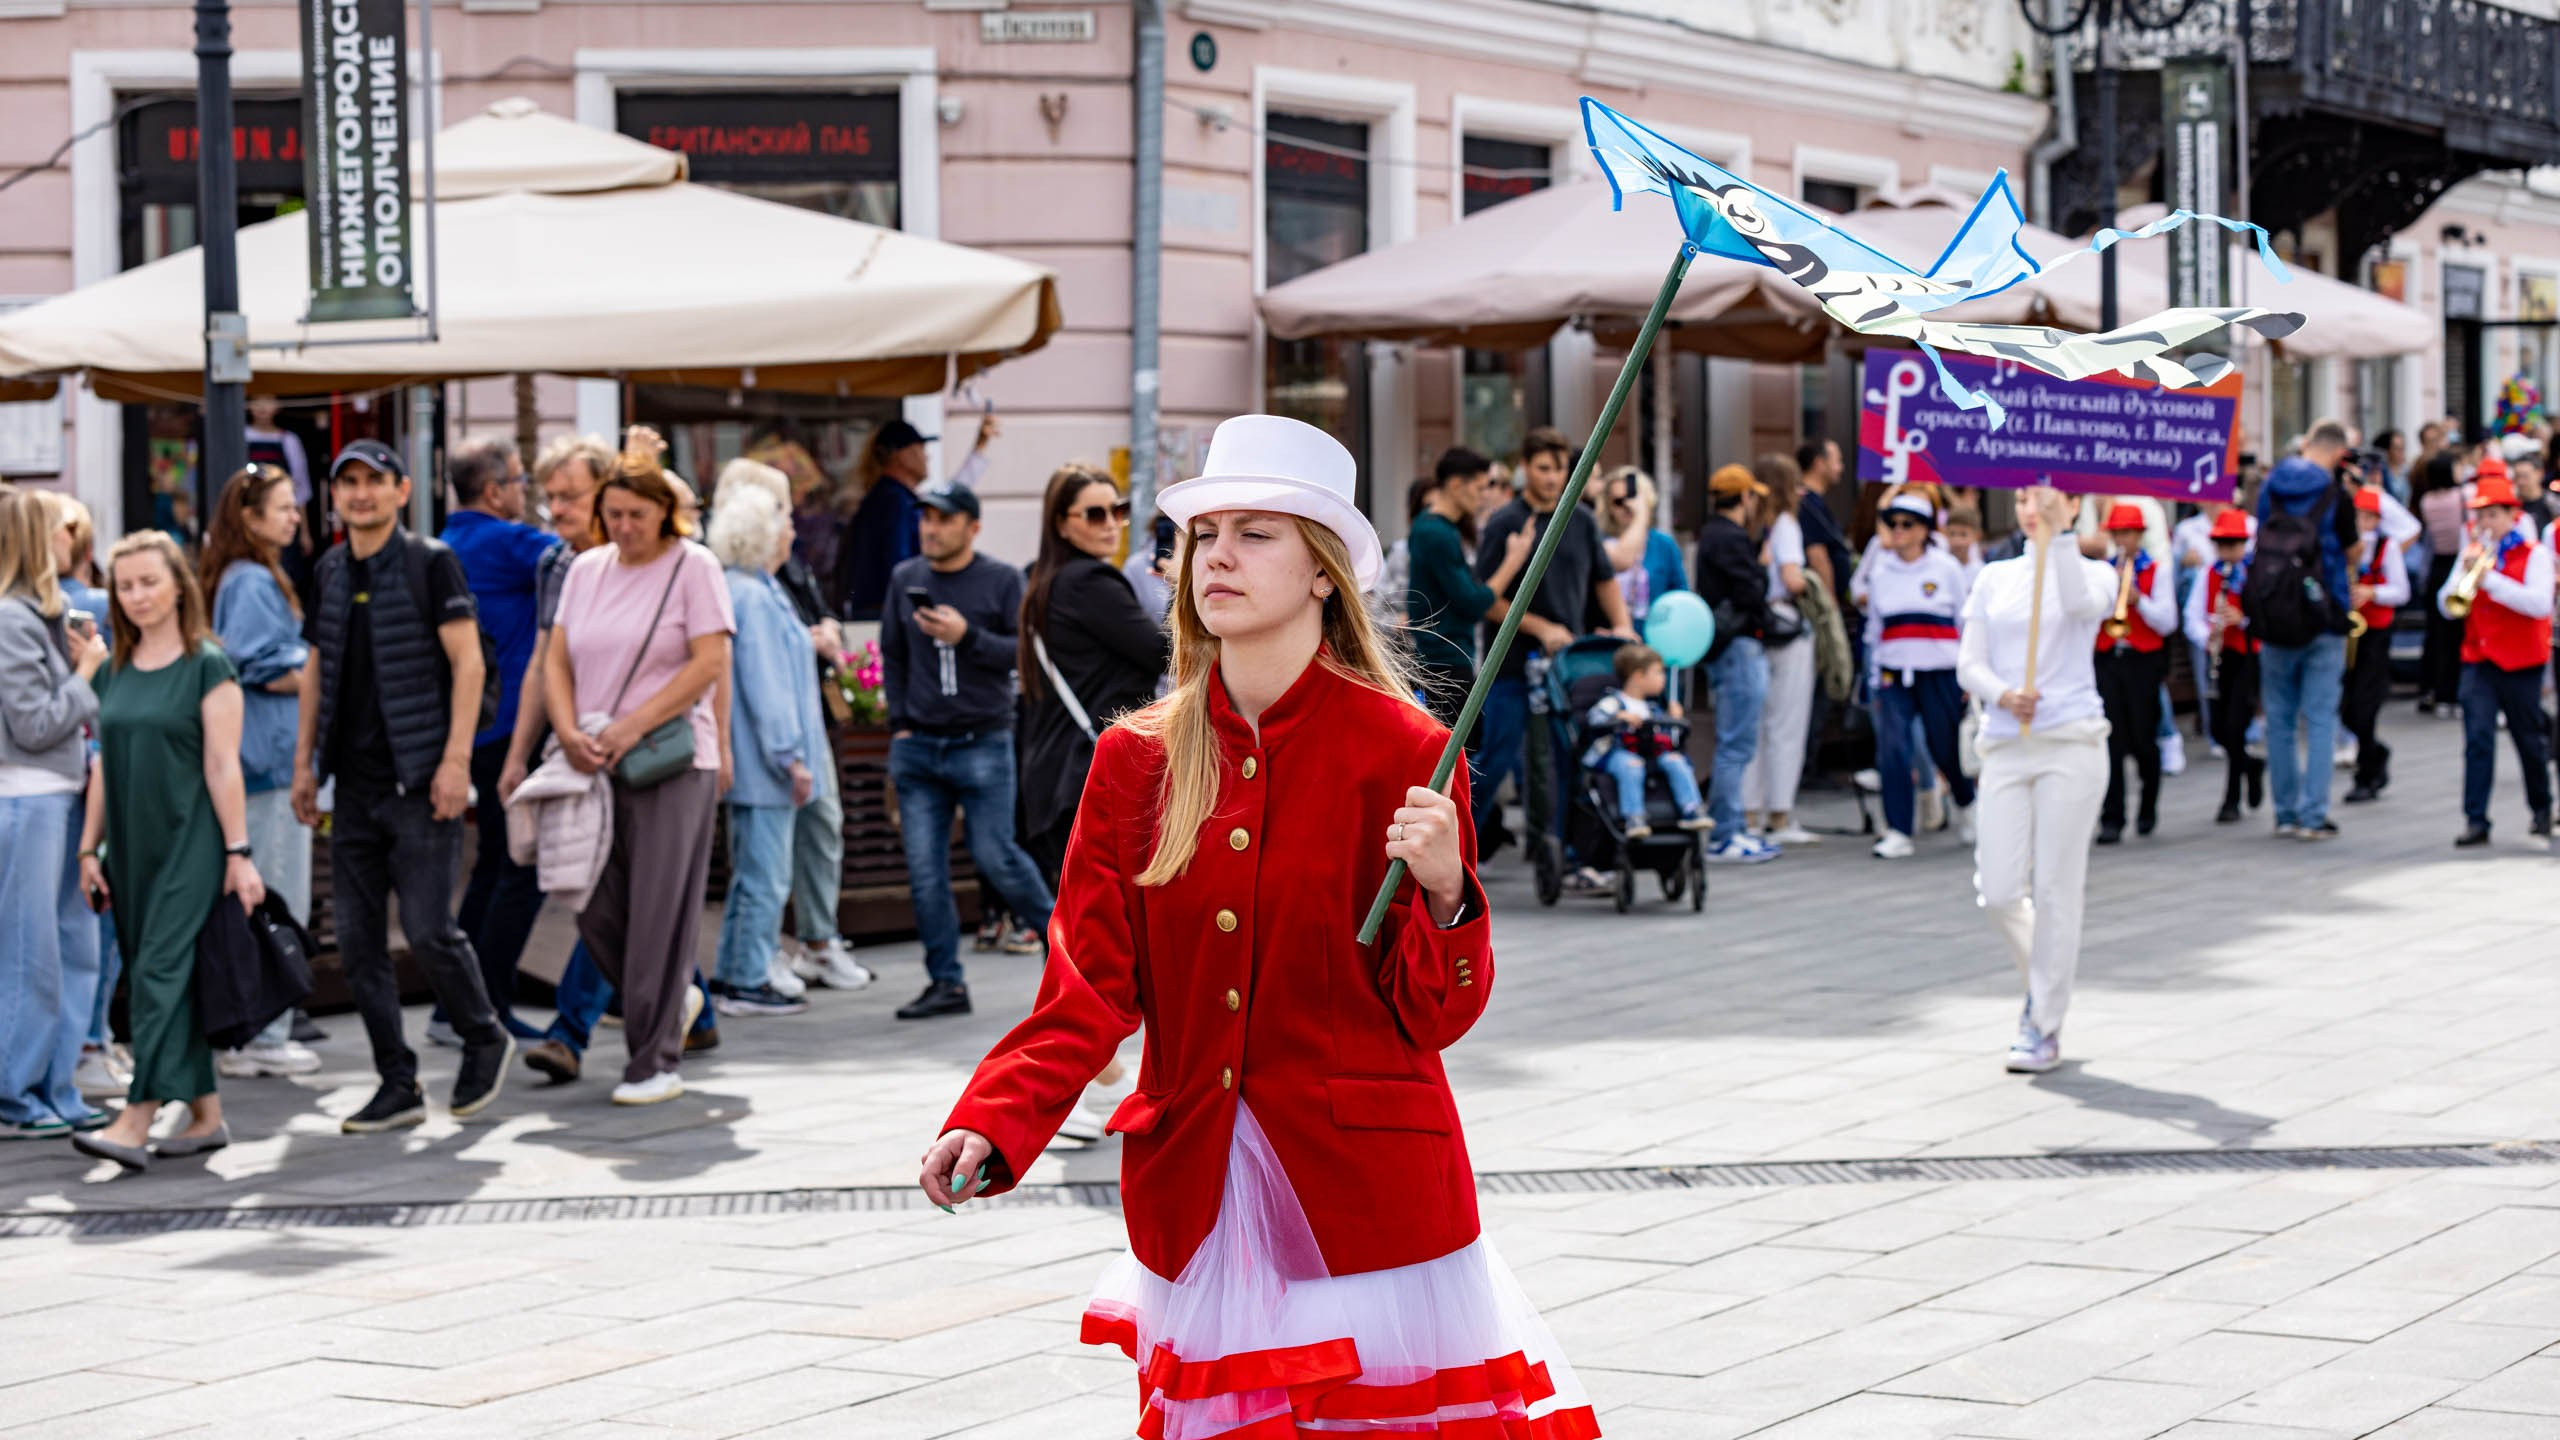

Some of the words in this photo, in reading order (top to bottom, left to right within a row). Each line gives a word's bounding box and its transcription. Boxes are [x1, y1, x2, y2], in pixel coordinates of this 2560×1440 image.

[168, 127, 272, 161] UON
[650, 121, 812, 155] БРИТАНСКИЙ
[819, 126, 870, 155] ПАБ
[368, 35, 402, 287] ОПОЛЧЕНИЕ
[1929, 380, 2029, 409] Сный
[2031, 383, 2119, 414] детский
[2124, 386, 2216, 420] духовой
[1915, 409, 2000, 434] оркест
[2034, 412, 2130, 440] Павлово,
[2135, 423, 2149, 439] г.
[2154, 421, 2226, 448] Выкса,
[1956, 438, 1970, 453] г.
[1975, 435, 2070, 460] Арзамас,
[2075, 446, 2089, 461] г.
[2094, 443, 2182, 471] Ворсма)
